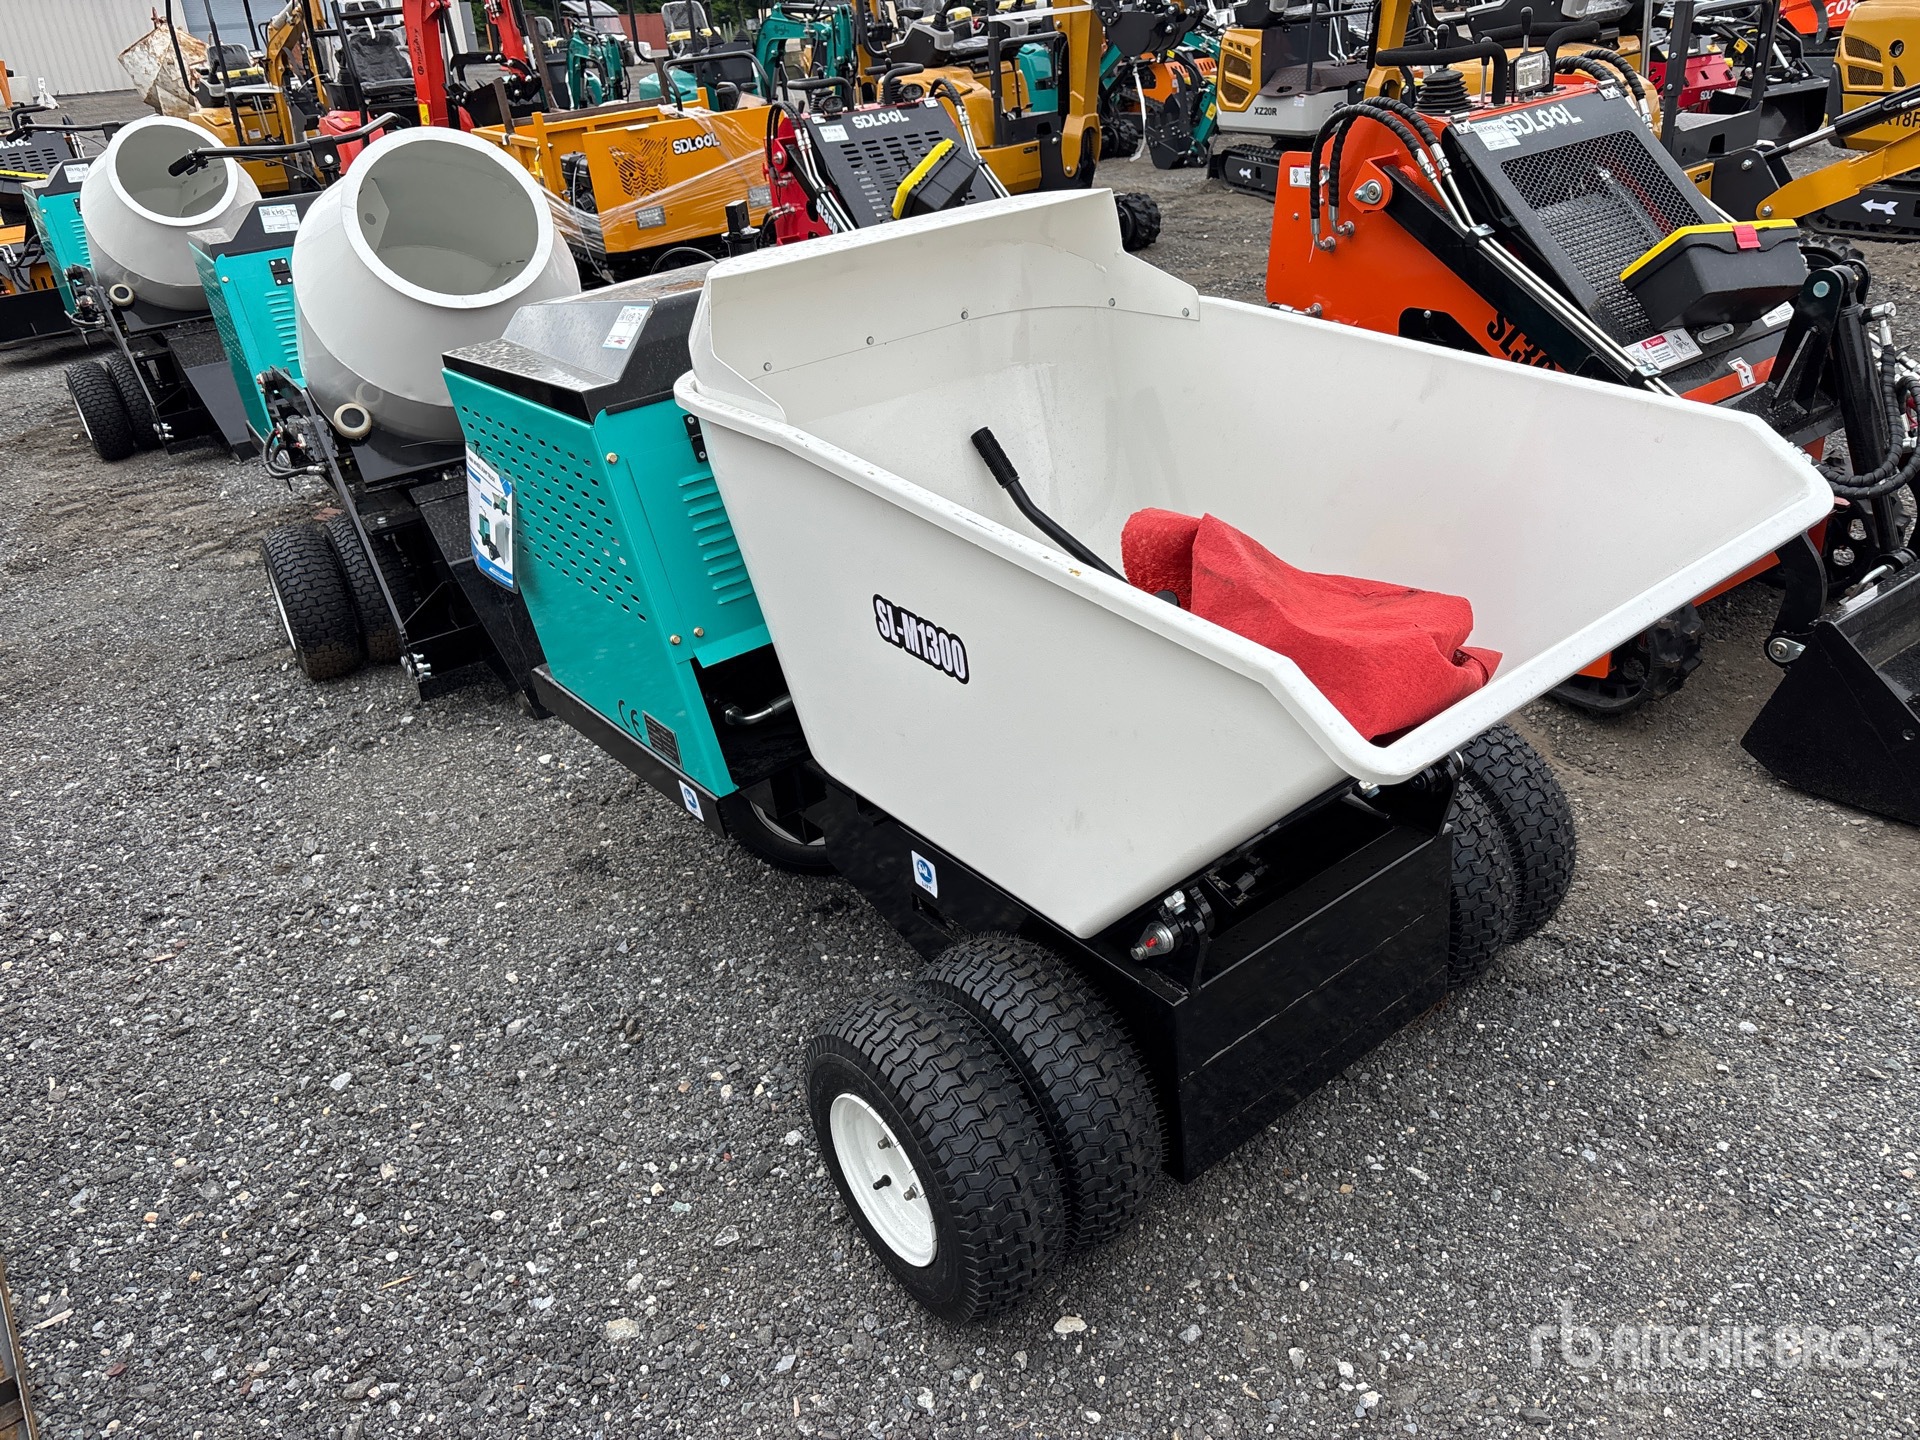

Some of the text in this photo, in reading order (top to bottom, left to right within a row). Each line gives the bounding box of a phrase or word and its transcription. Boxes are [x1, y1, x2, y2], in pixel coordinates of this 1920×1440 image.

[852, 110, 909, 129] SDLOOL
[1254, 106, 1278, 116] XZ20R
[1501, 104, 1582, 136] SDLOOL
[672, 131, 720, 156] SDLOOL
[873, 594, 969, 684] SL-M1300
